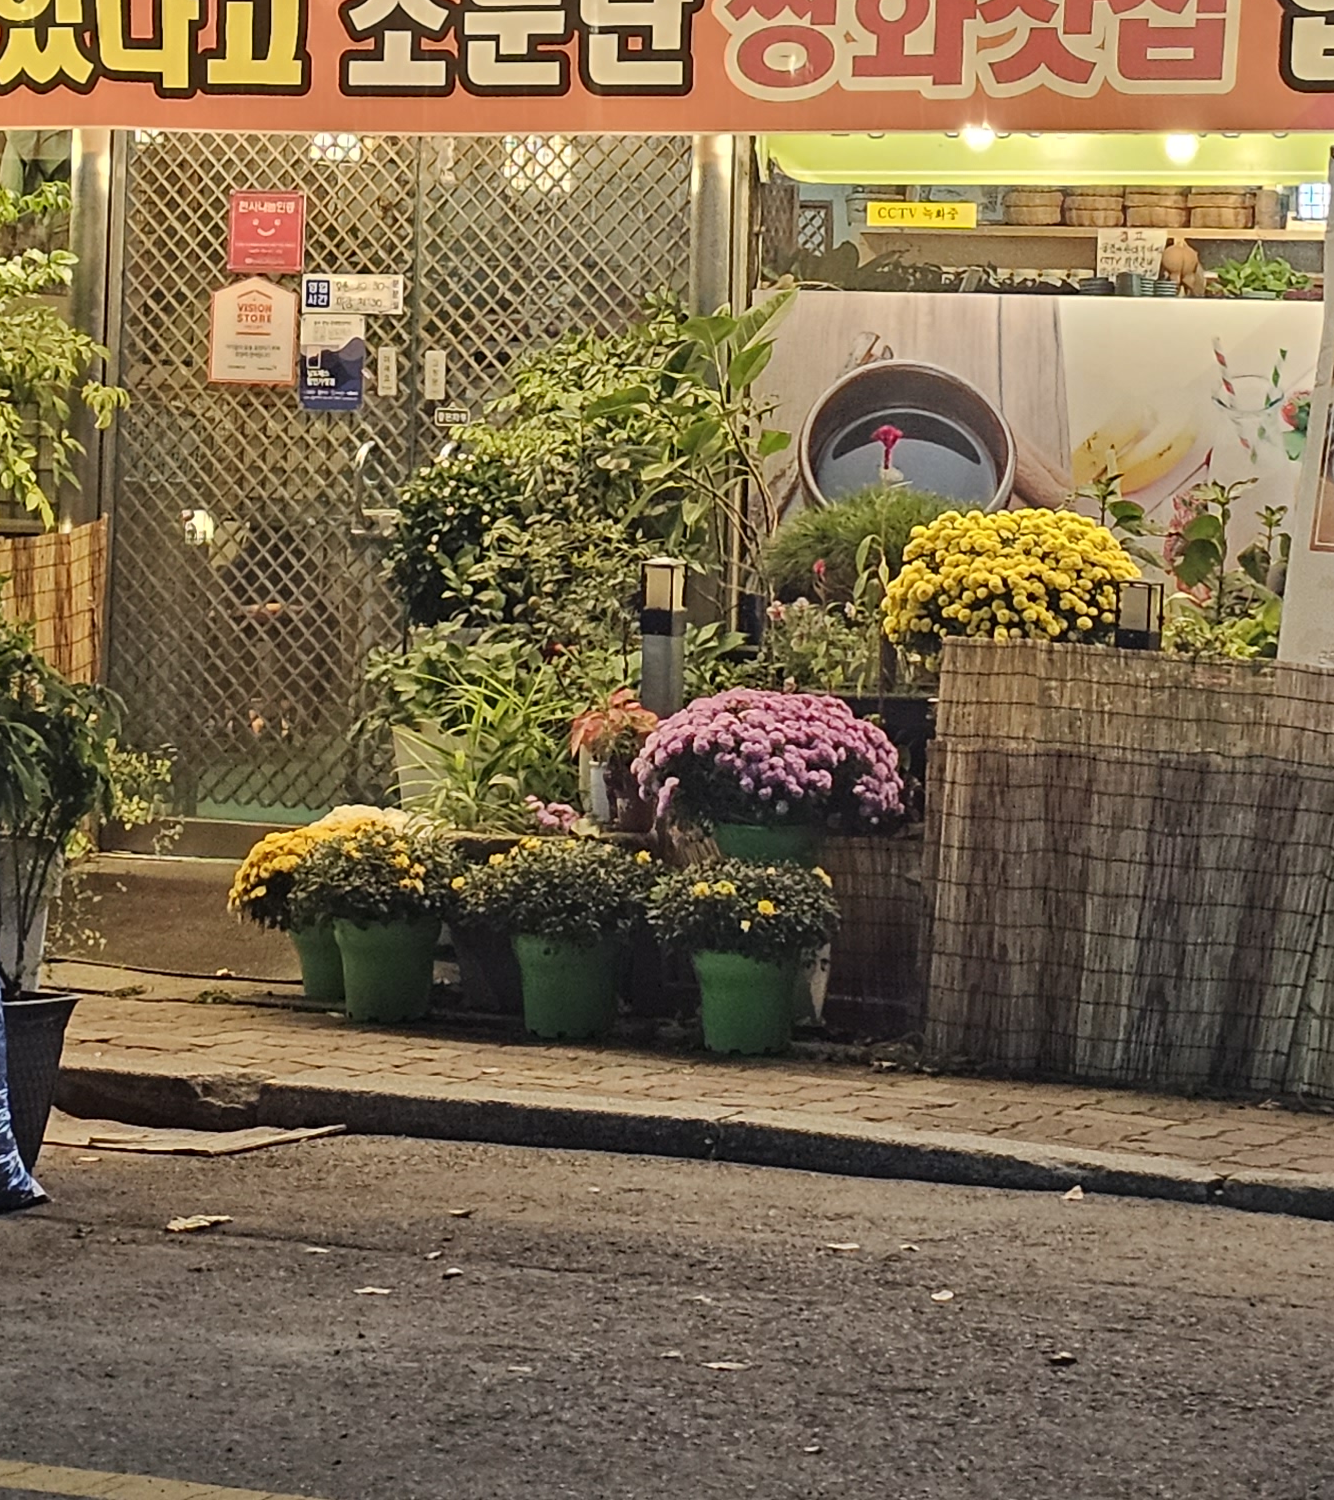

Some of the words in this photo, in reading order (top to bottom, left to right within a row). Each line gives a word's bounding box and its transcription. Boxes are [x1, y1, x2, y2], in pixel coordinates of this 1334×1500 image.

[877, 206, 917, 220] CCTV
[236, 302, 273, 313] VISION
[236, 313, 273, 324] STORE
